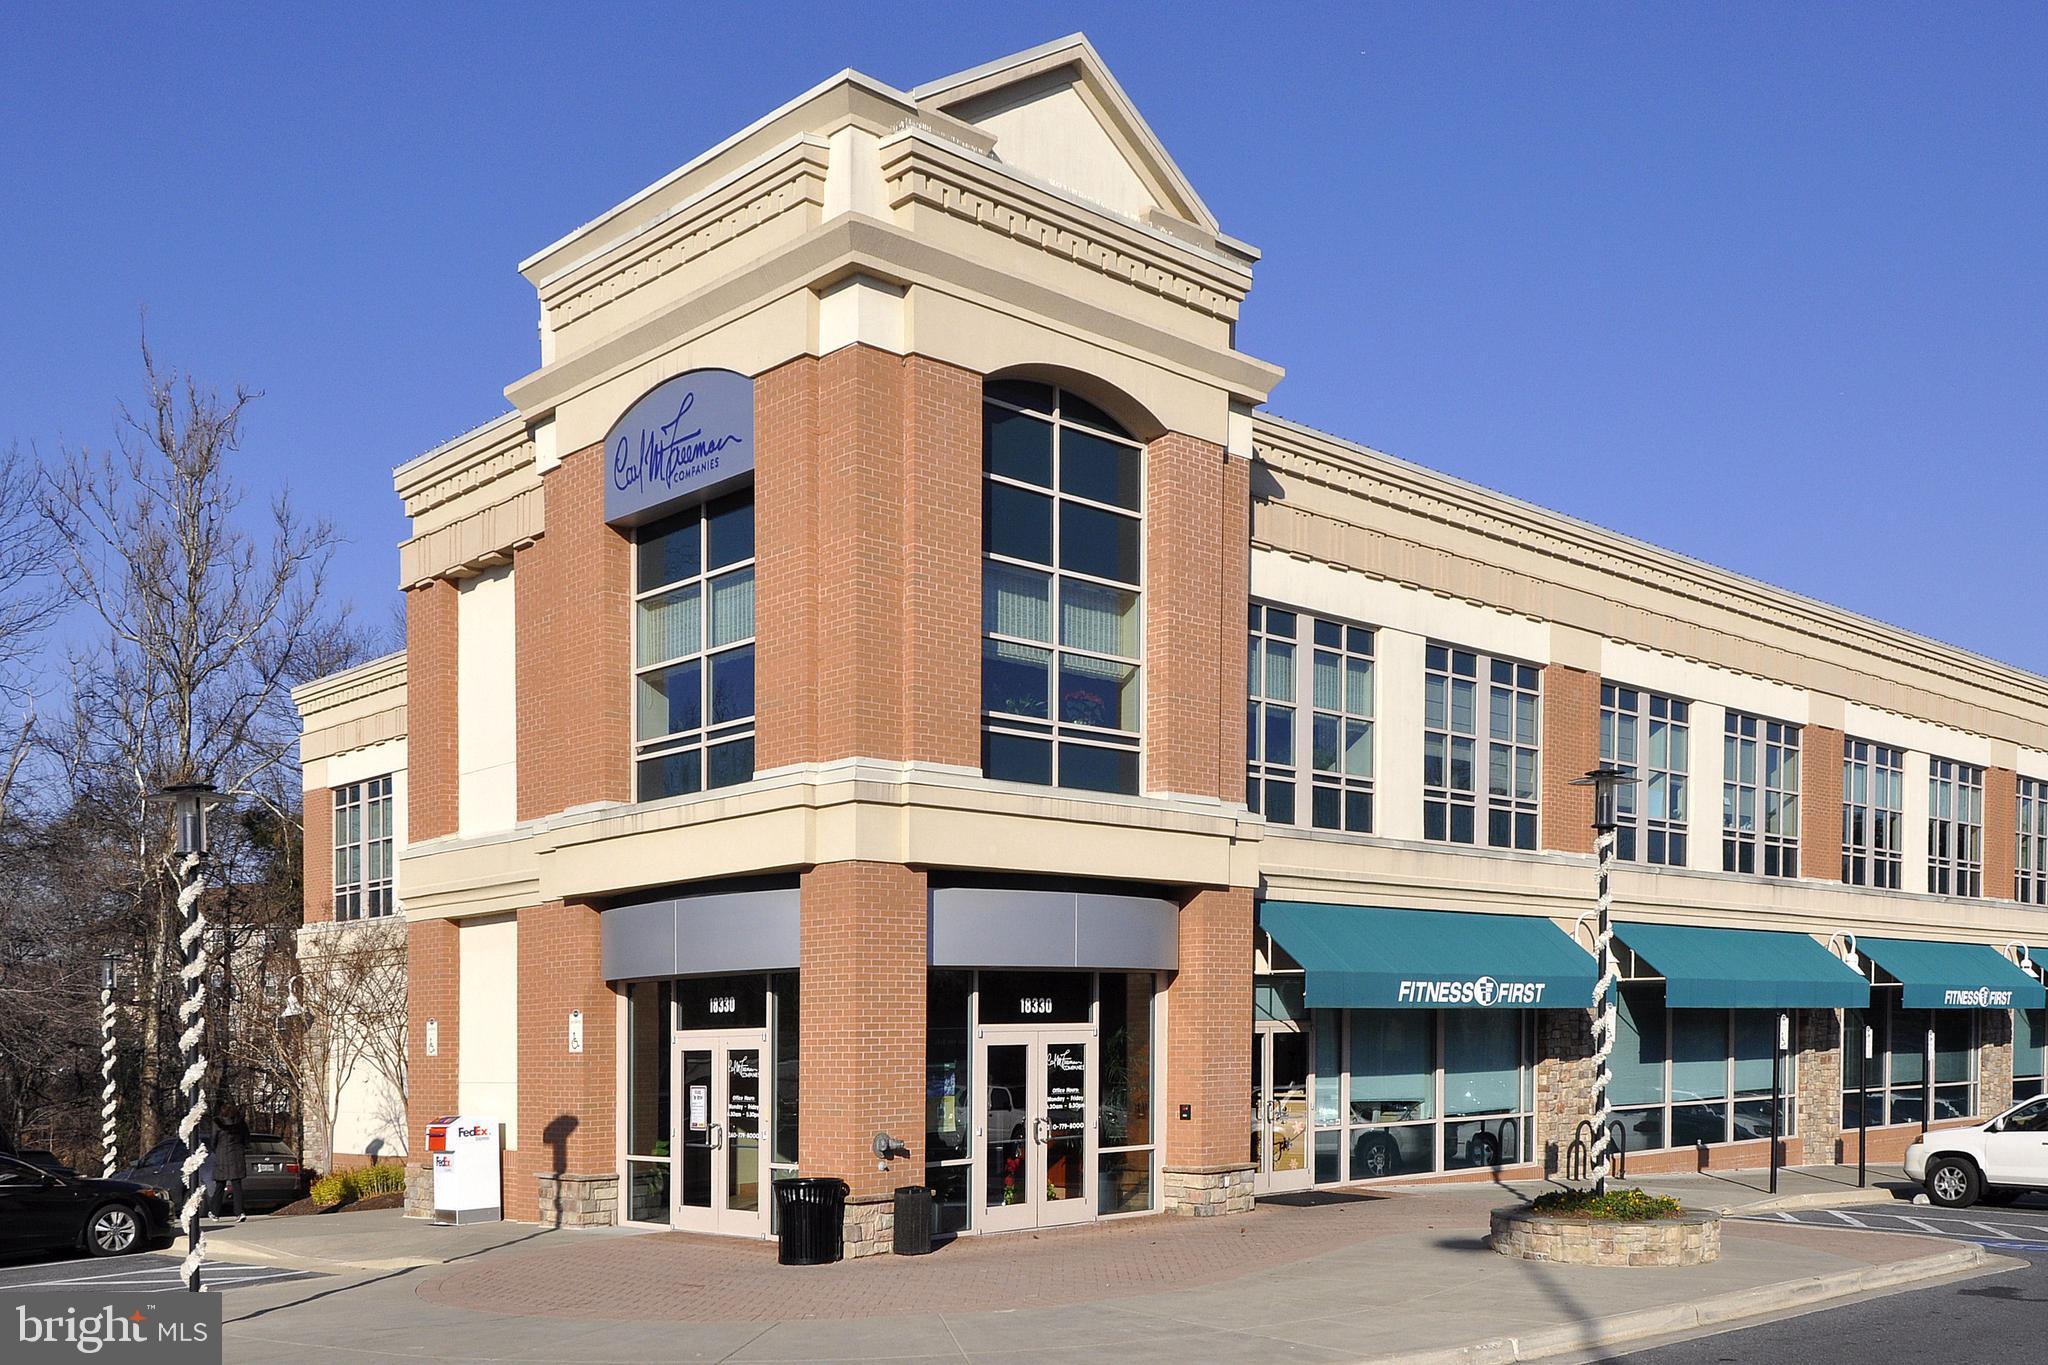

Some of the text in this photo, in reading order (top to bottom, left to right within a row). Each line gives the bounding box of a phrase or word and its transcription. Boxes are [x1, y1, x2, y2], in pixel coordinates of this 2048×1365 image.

[614, 429, 645, 494] Carl
[660, 392, 742, 490] Freeman
[673, 457, 720, 483] COMPANIES
[1398, 981, 1545, 1003] FITNESS FIRST
[1944, 990, 2012, 1005] FITNESS FIRST
[709, 996, 735, 1014] 18330
[1020, 997, 1053, 1014] 18330
[458, 1126, 488, 1138] FedEx
